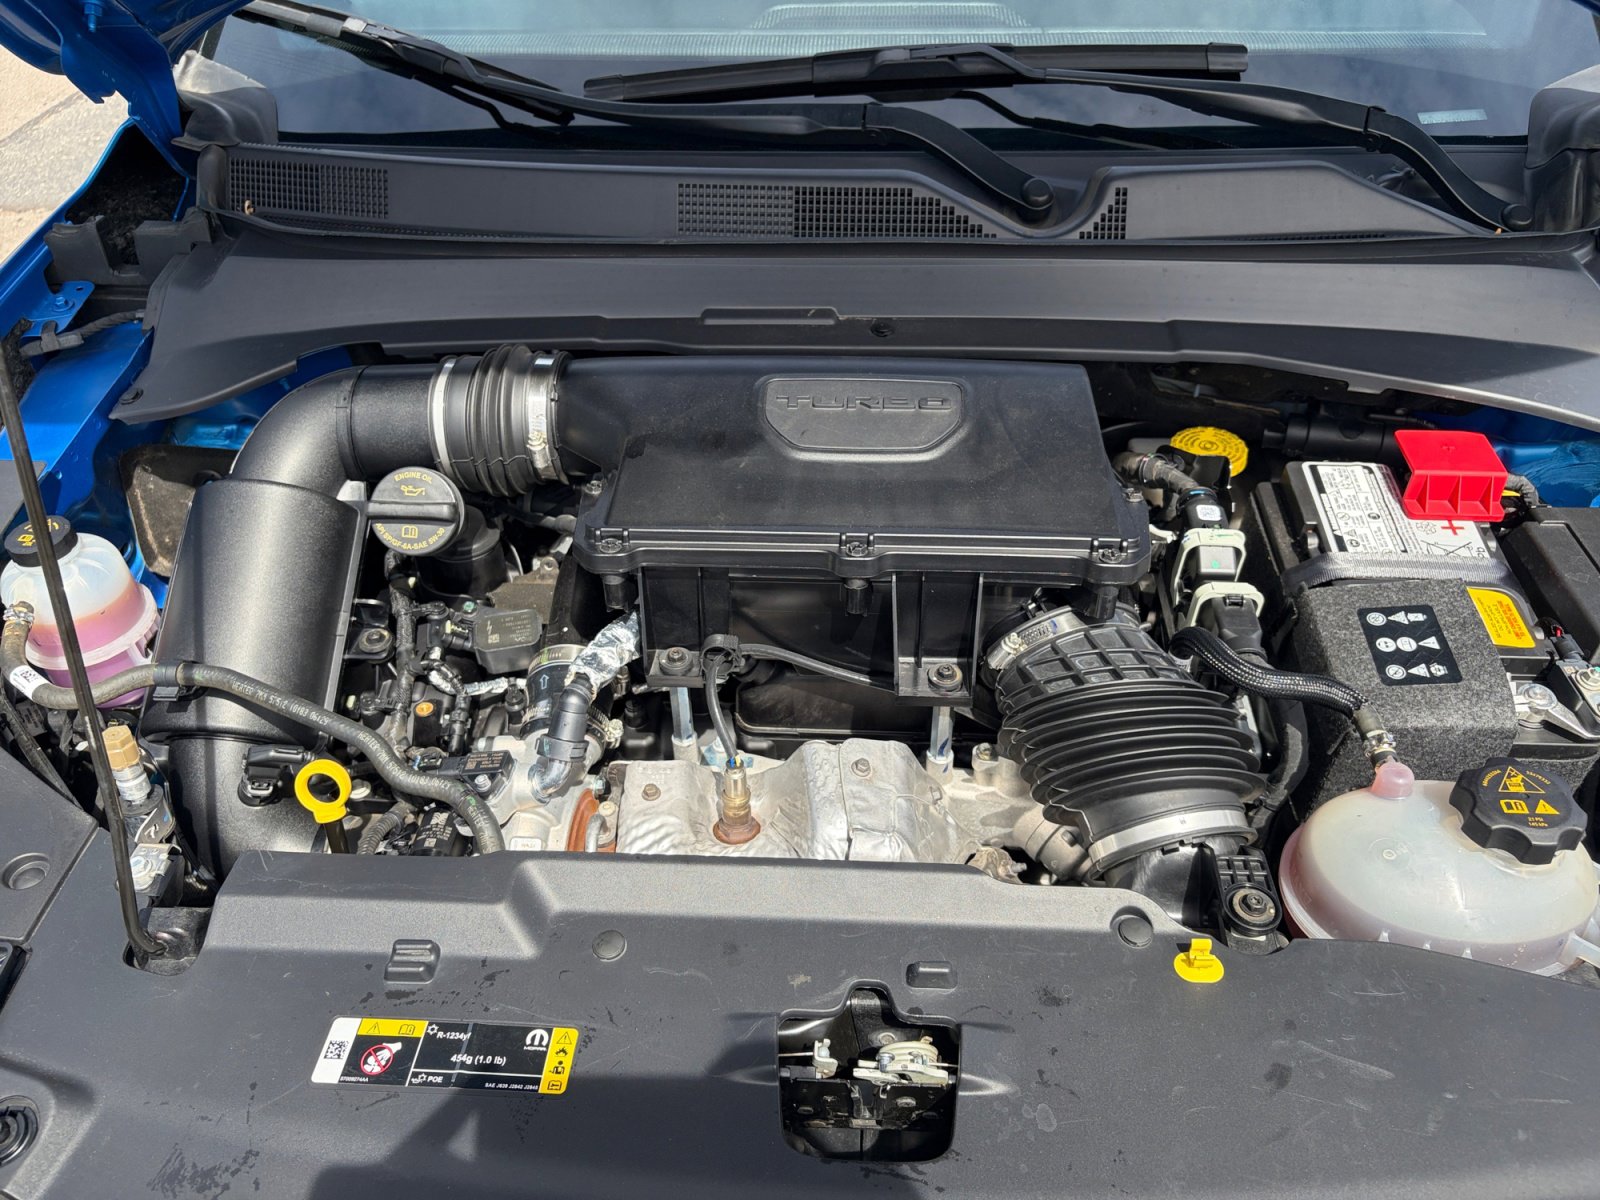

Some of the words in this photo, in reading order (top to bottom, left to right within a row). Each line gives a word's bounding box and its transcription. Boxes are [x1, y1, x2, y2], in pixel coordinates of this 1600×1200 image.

[776, 394, 952, 412] TURBO
[394, 472, 421, 481] ENGINE
[422, 474, 433, 484] OIL
[375, 523, 385, 535] API
[429, 527, 446, 545] 5W-30
[437, 1030, 472, 1042] R-1234yf
[450, 1053, 473, 1065] 454g
[474, 1055, 491, 1065] (1.0
[493, 1056, 507, 1067] lb)
[427, 1075, 443, 1083] POE
